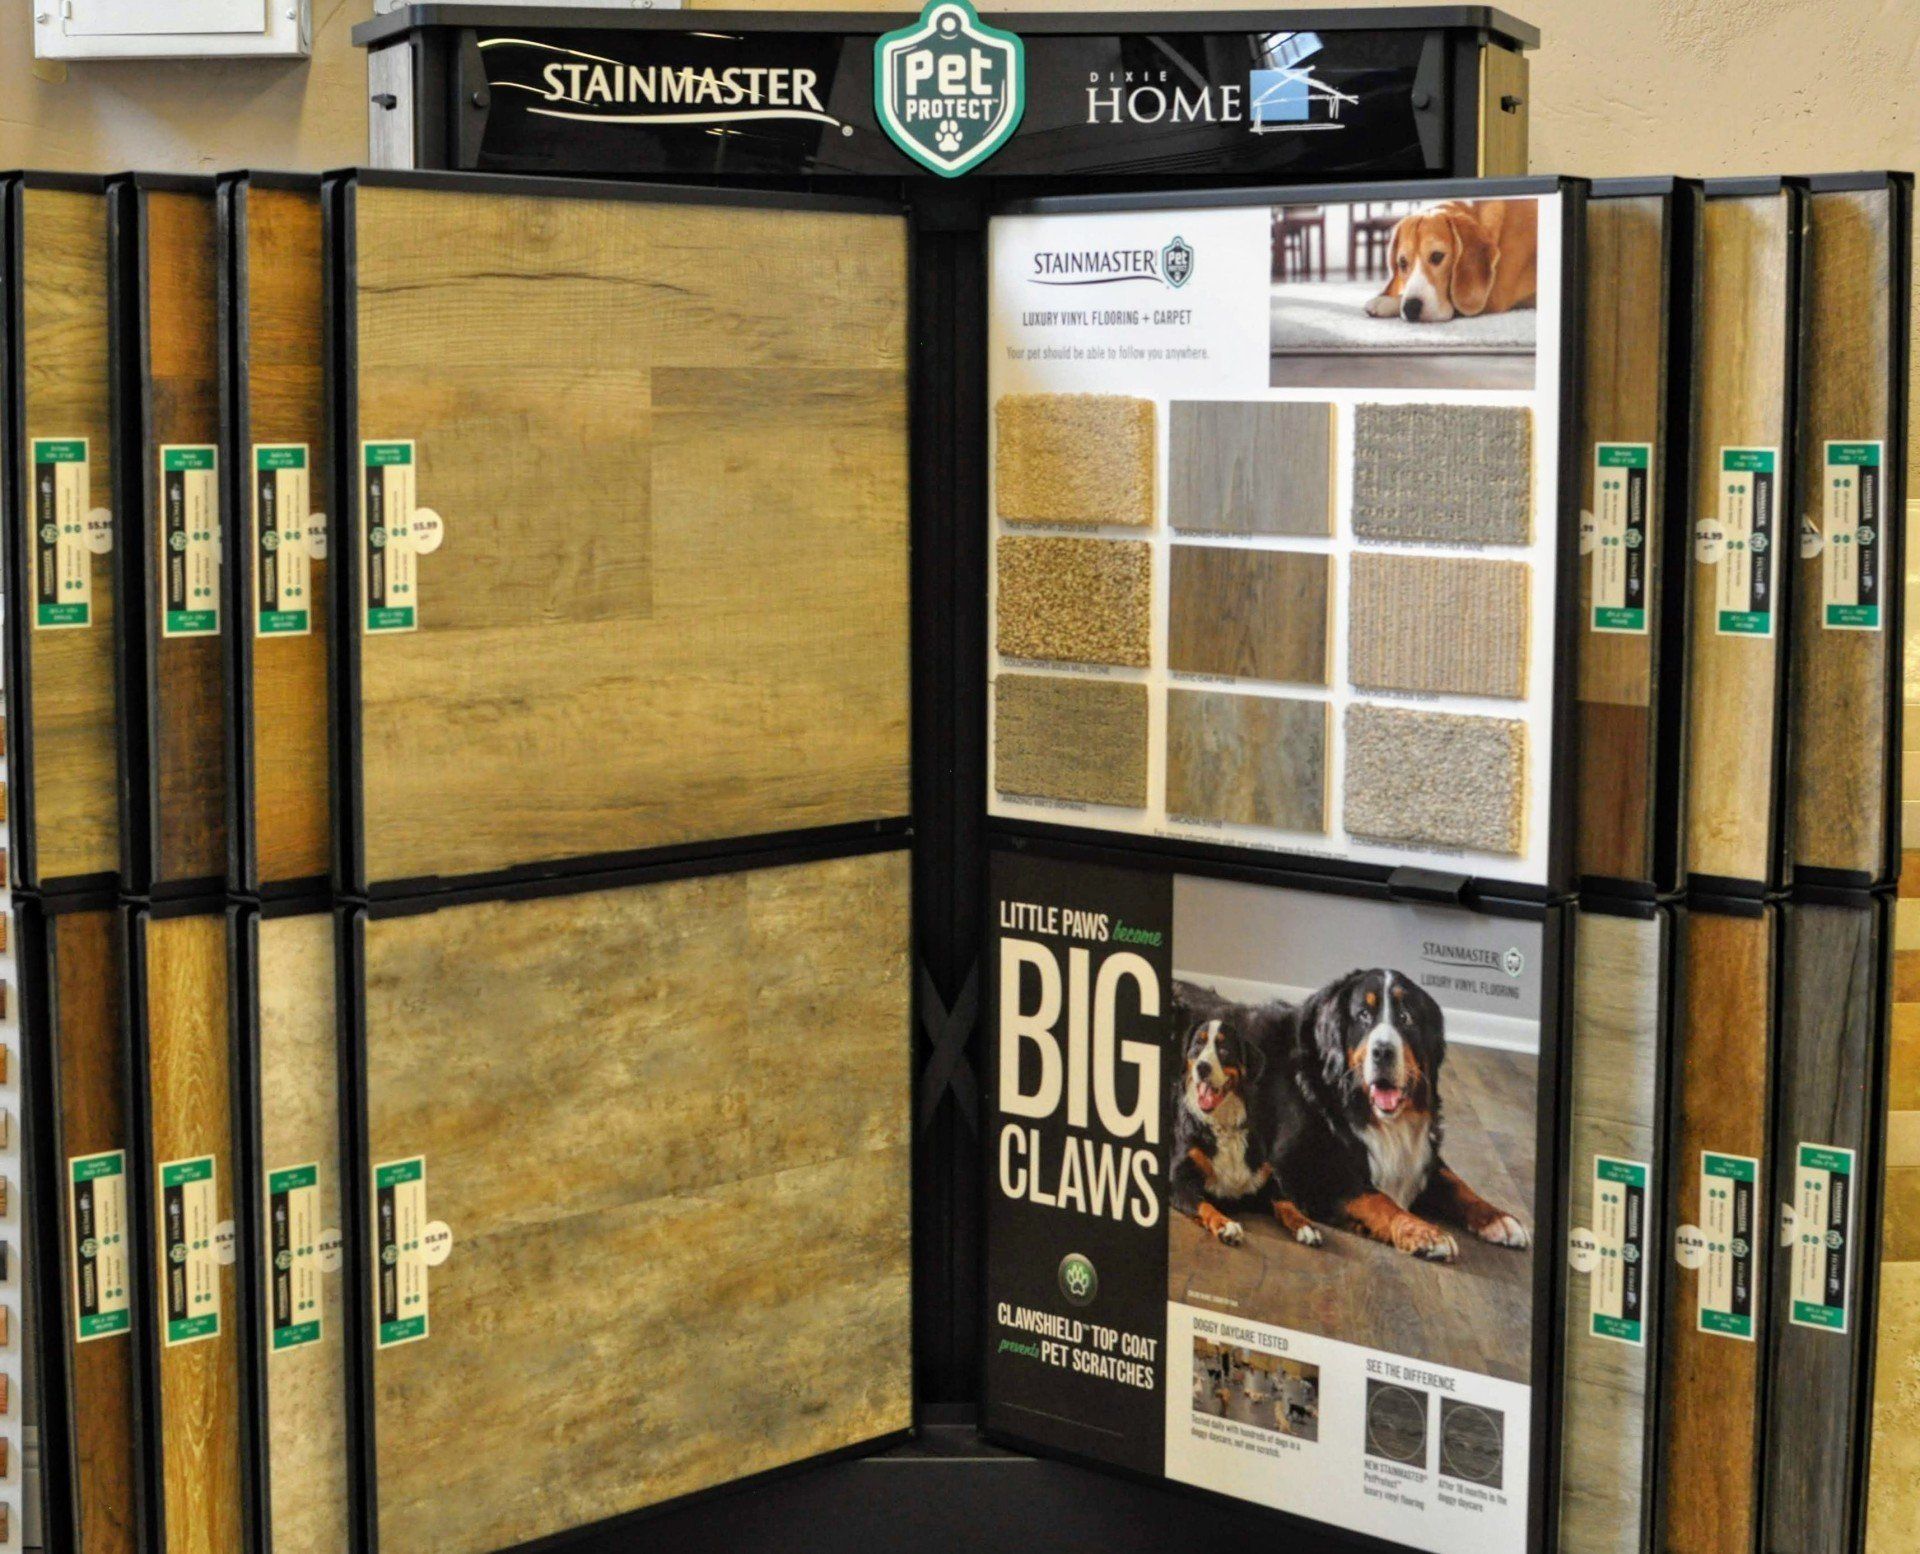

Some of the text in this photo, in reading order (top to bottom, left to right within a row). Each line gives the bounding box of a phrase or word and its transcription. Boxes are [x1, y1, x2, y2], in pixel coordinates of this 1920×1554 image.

[543, 63, 824, 112] STAINMASTER
[906, 48, 992, 96] Pet
[1090, 71, 1167, 82] DIXIE
[1086, 85, 1242, 124] HOME
[1034, 250, 1157, 274] STAINMASTER
[1022, 311, 1059, 327] LUXURY
[1061, 311, 1089, 326] VINYL
[1091, 310, 1139, 326] FLOORING
[1153, 310, 1192, 325] CARPET
[1027, 347, 1041, 361] pet
[1043, 346, 1071, 360] should
[1073, 347, 1085, 360] be
[1107, 347, 1116, 360] to
[1118, 345, 1145, 360] follow
[1147, 348, 1163, 361] you
[1000, 901, 1162, 946] LITTLE PAWS become
[1423, 942, 1500, 966] STAINMASTER
[1000, 937, 1160, 1144] BIG
[1000, 1123, 1159, 1228] CLAWS
[1091, 1325, 1118, 1351] TOP
[1121, 1333, 1157, 1361] COAT
[1193, 1317, 1289, 1351] DOGGY DAYCARE TESTED
[998, 1339, 1154, 1390] prevents PET SCRATCHES
[1366, 1358, 1456, 1391] SEE THE DIFFERENCE
